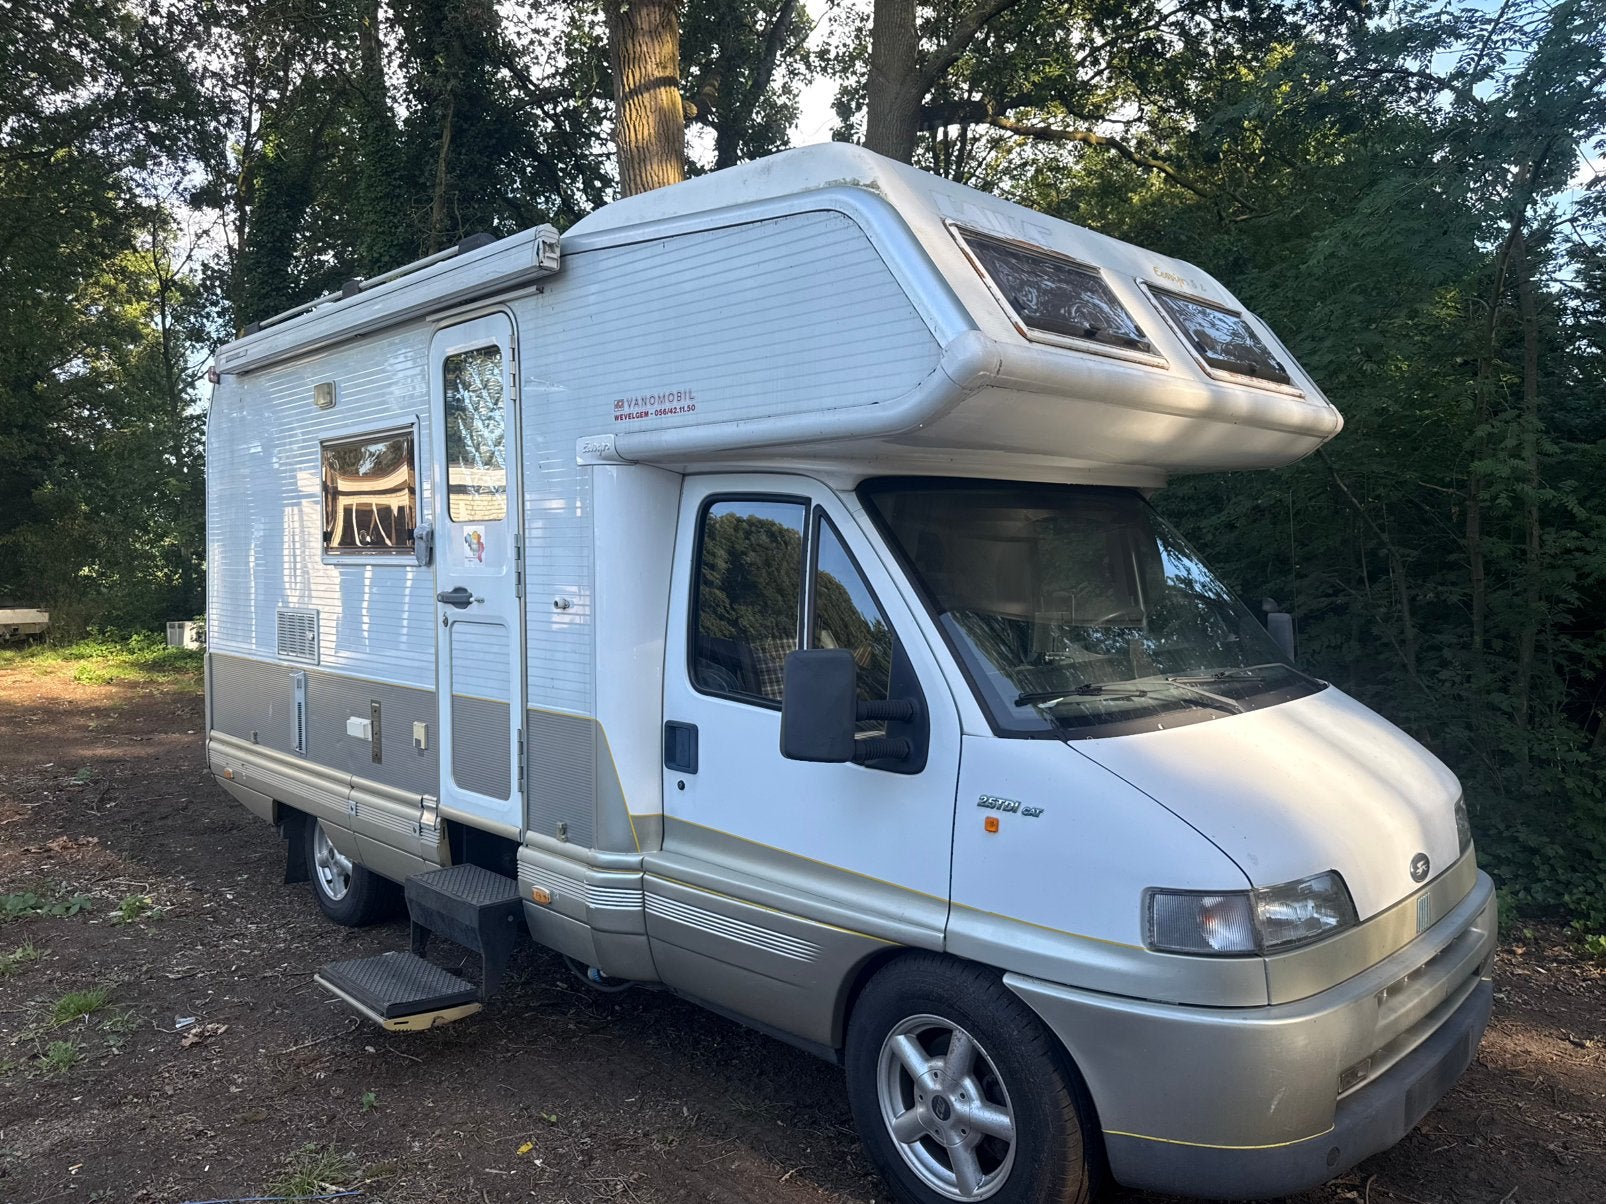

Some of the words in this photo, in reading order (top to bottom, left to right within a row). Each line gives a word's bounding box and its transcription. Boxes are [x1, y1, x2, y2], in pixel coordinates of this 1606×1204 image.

[626, 389, 695, 408] VANOMOBIL
[614, 410, 649, 421] WEVELGEM
[654, 404, 696, 416] 056/42.11.50
[1021, 807, 1044, 818] CAT
